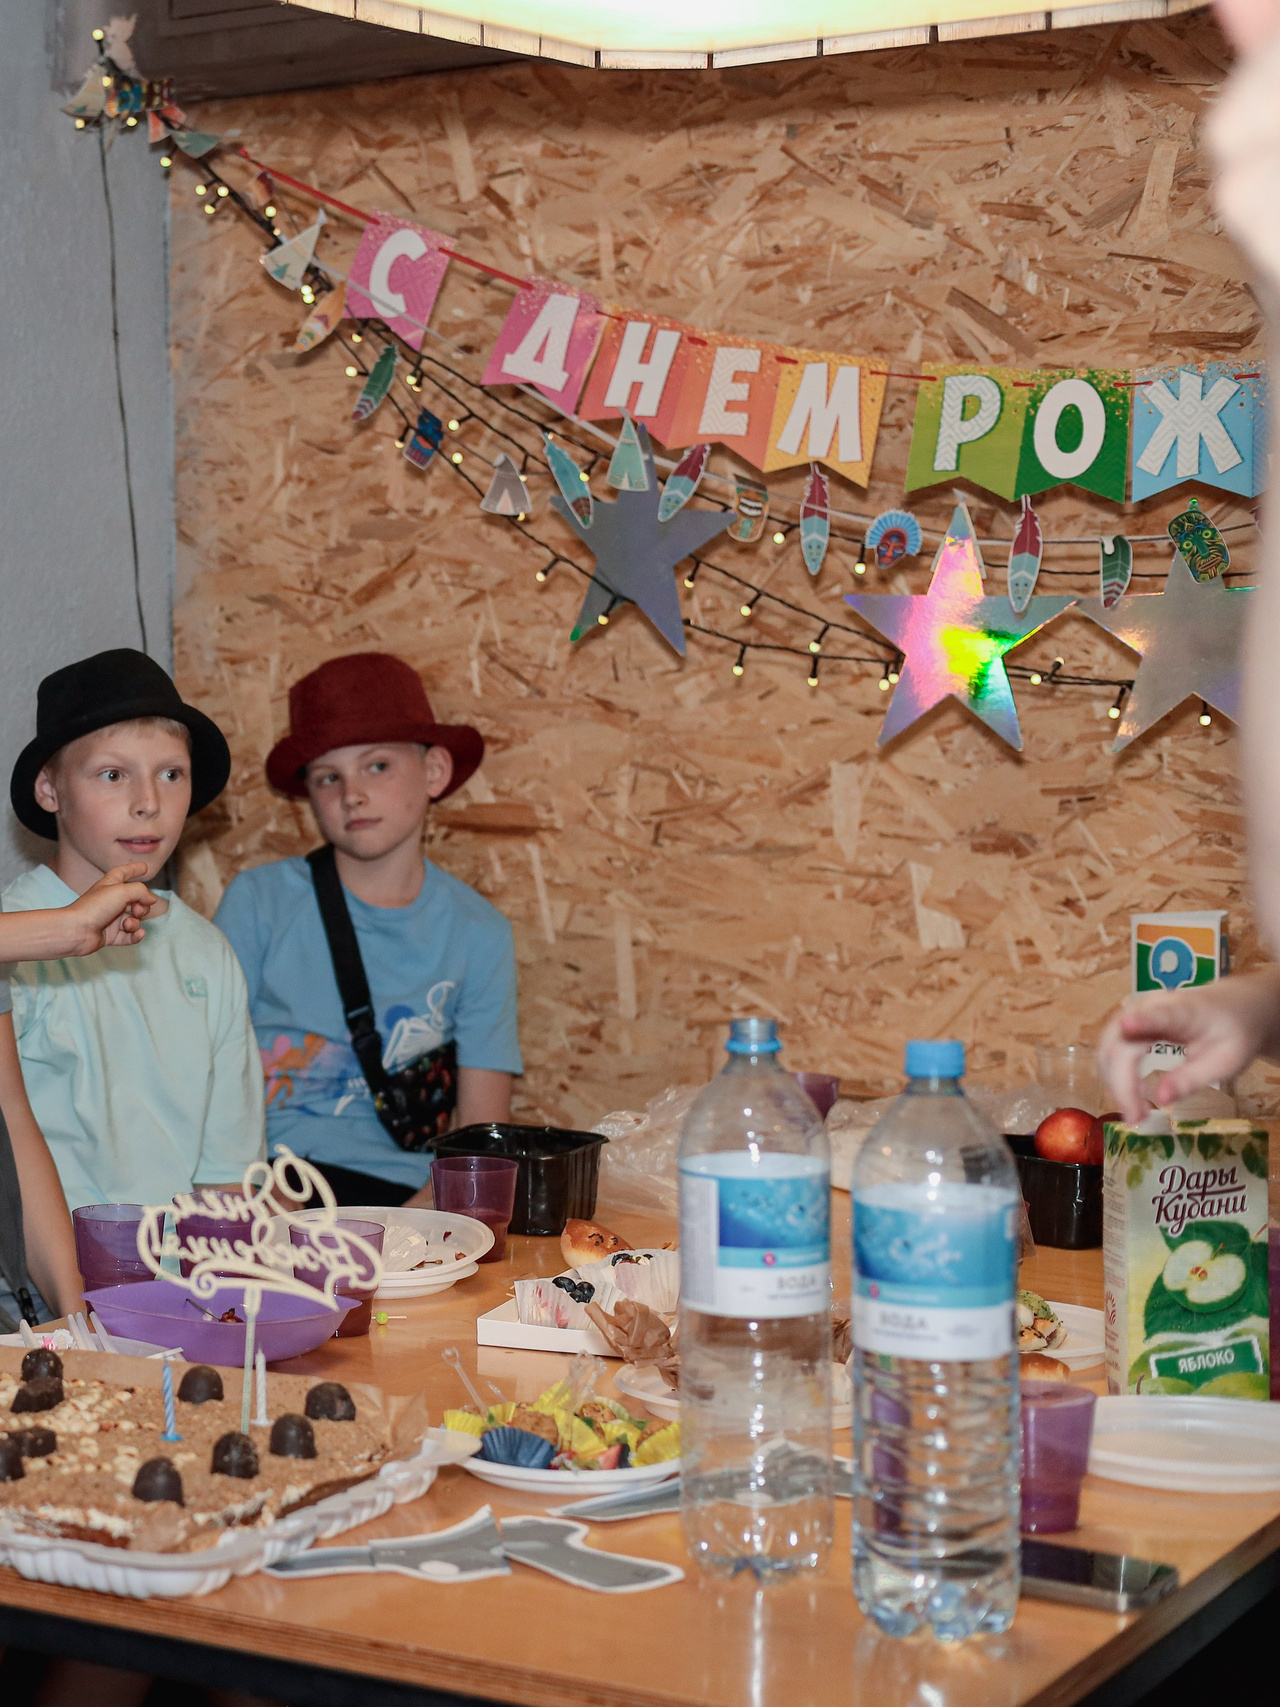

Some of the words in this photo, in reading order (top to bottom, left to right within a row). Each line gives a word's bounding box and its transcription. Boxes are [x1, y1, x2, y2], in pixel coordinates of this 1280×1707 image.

[368, 228, 428, 318] С
[501, 293, 864, 464] ДНЕМ
[1158, 1165, 1239, 1201] Дары
[1151, 1184, 1248, 1235] Кубани
[1178, 1348, 1236, 1375] ЯБЛОКО
